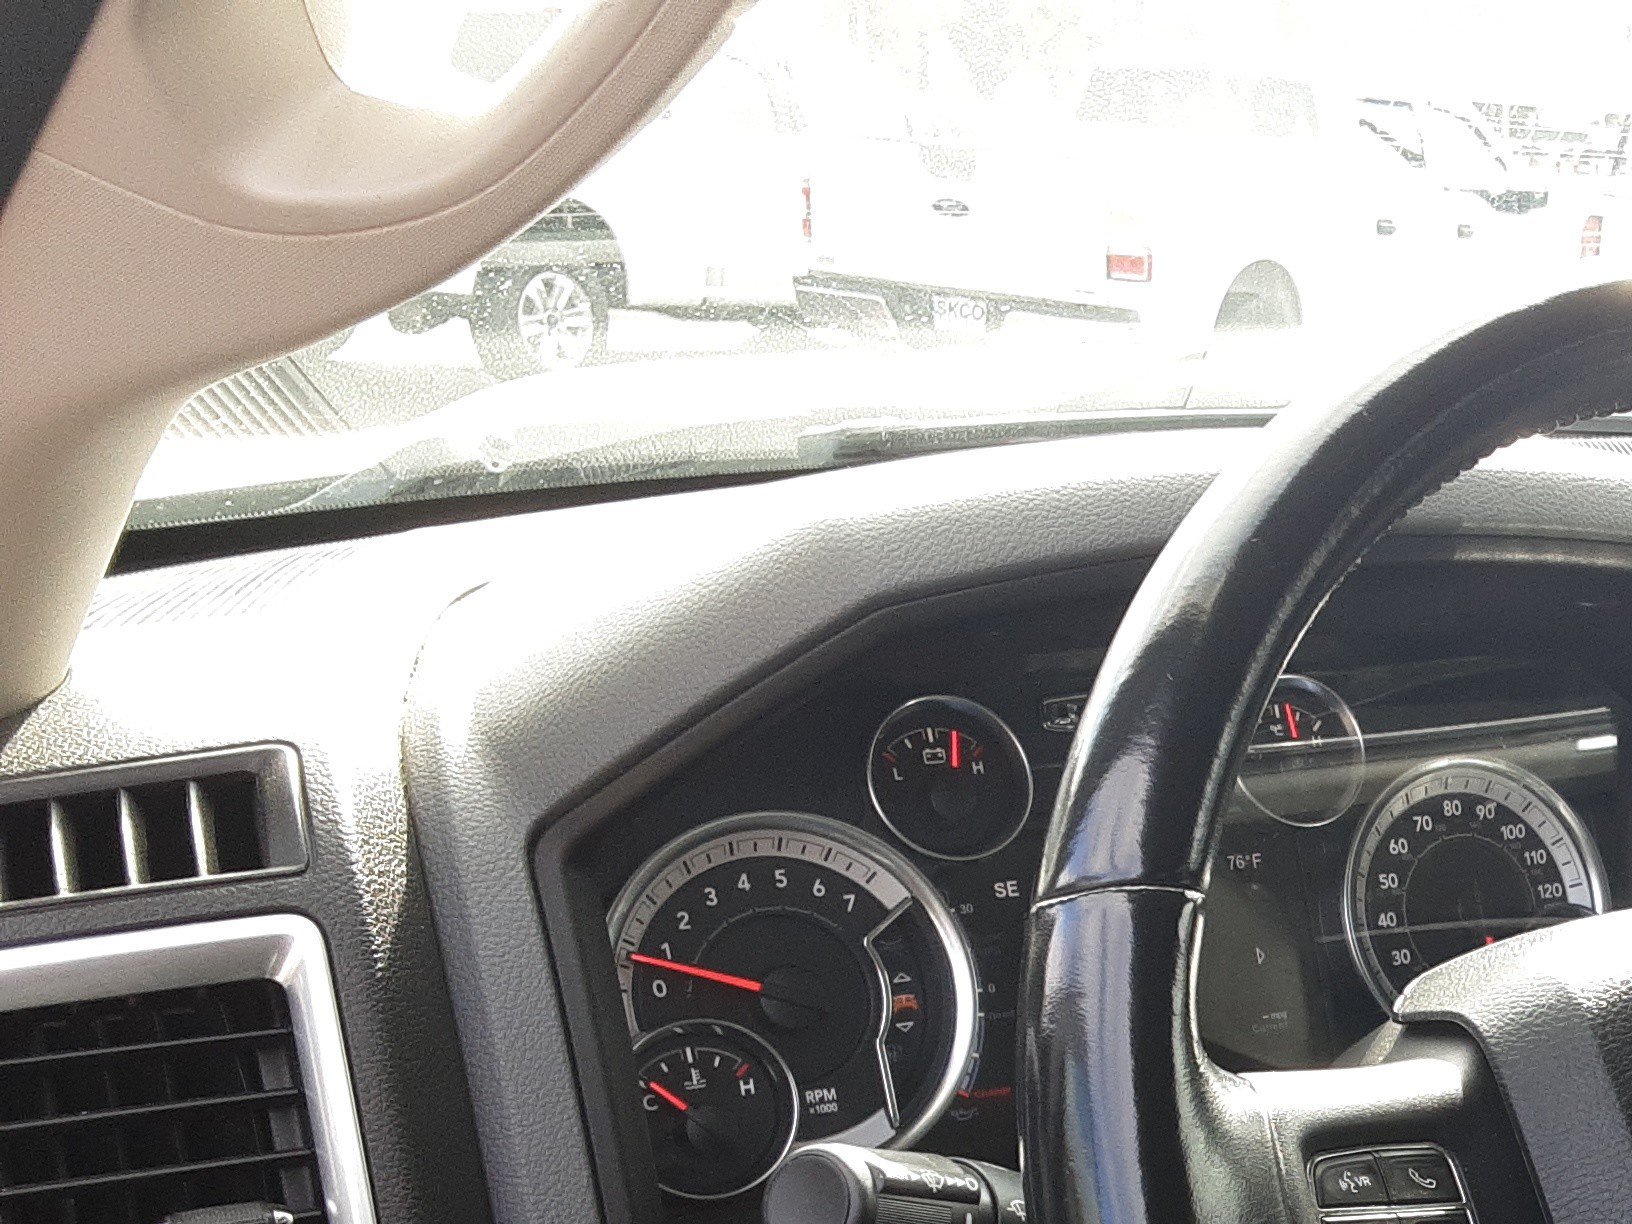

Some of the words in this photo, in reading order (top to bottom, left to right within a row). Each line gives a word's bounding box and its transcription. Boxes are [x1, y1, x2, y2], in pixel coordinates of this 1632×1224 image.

[938, 300, 985, 320] SKCO
[892, 767, 904, 781] L
[972, 761, 985, 775] H
[1443, 800, 1462, 817] 80
[1475, 804, 1495, 821] 90
[1412, 815, 1433, 832] 70
[1500, 823, 1526, 841] 100
[1389, 837, 1409, 855] 60
[1226, 853, 1262, 871] 76°F
[1524, 849, 1547, 867] 110
[737, 873, 751, 891] 4
[774, 869, 788, 888] 5
[813, 878, 826, 897] 6
[1378, 873, 1399, 890] 50
[704, 887, 718, 906] 3
[994, 880, 1020, 899] SE
[1537, 882, 1563, 899] 120
[843, 894, 856, 912] 7
[676, 911, 692, 930] 2
[1377, 911, 1397, 928] 40
[660, 942, 672, 960] 1
[1391, 949, 1411, 966] 30
[652, 979, 667, 998] 0
[739, 1078, 755, 1096] H
[805, 1087, 837, 1104] RPM
[643, 1095, 659, 1111] C
[1354, 1175, 1372, 1187] VR
